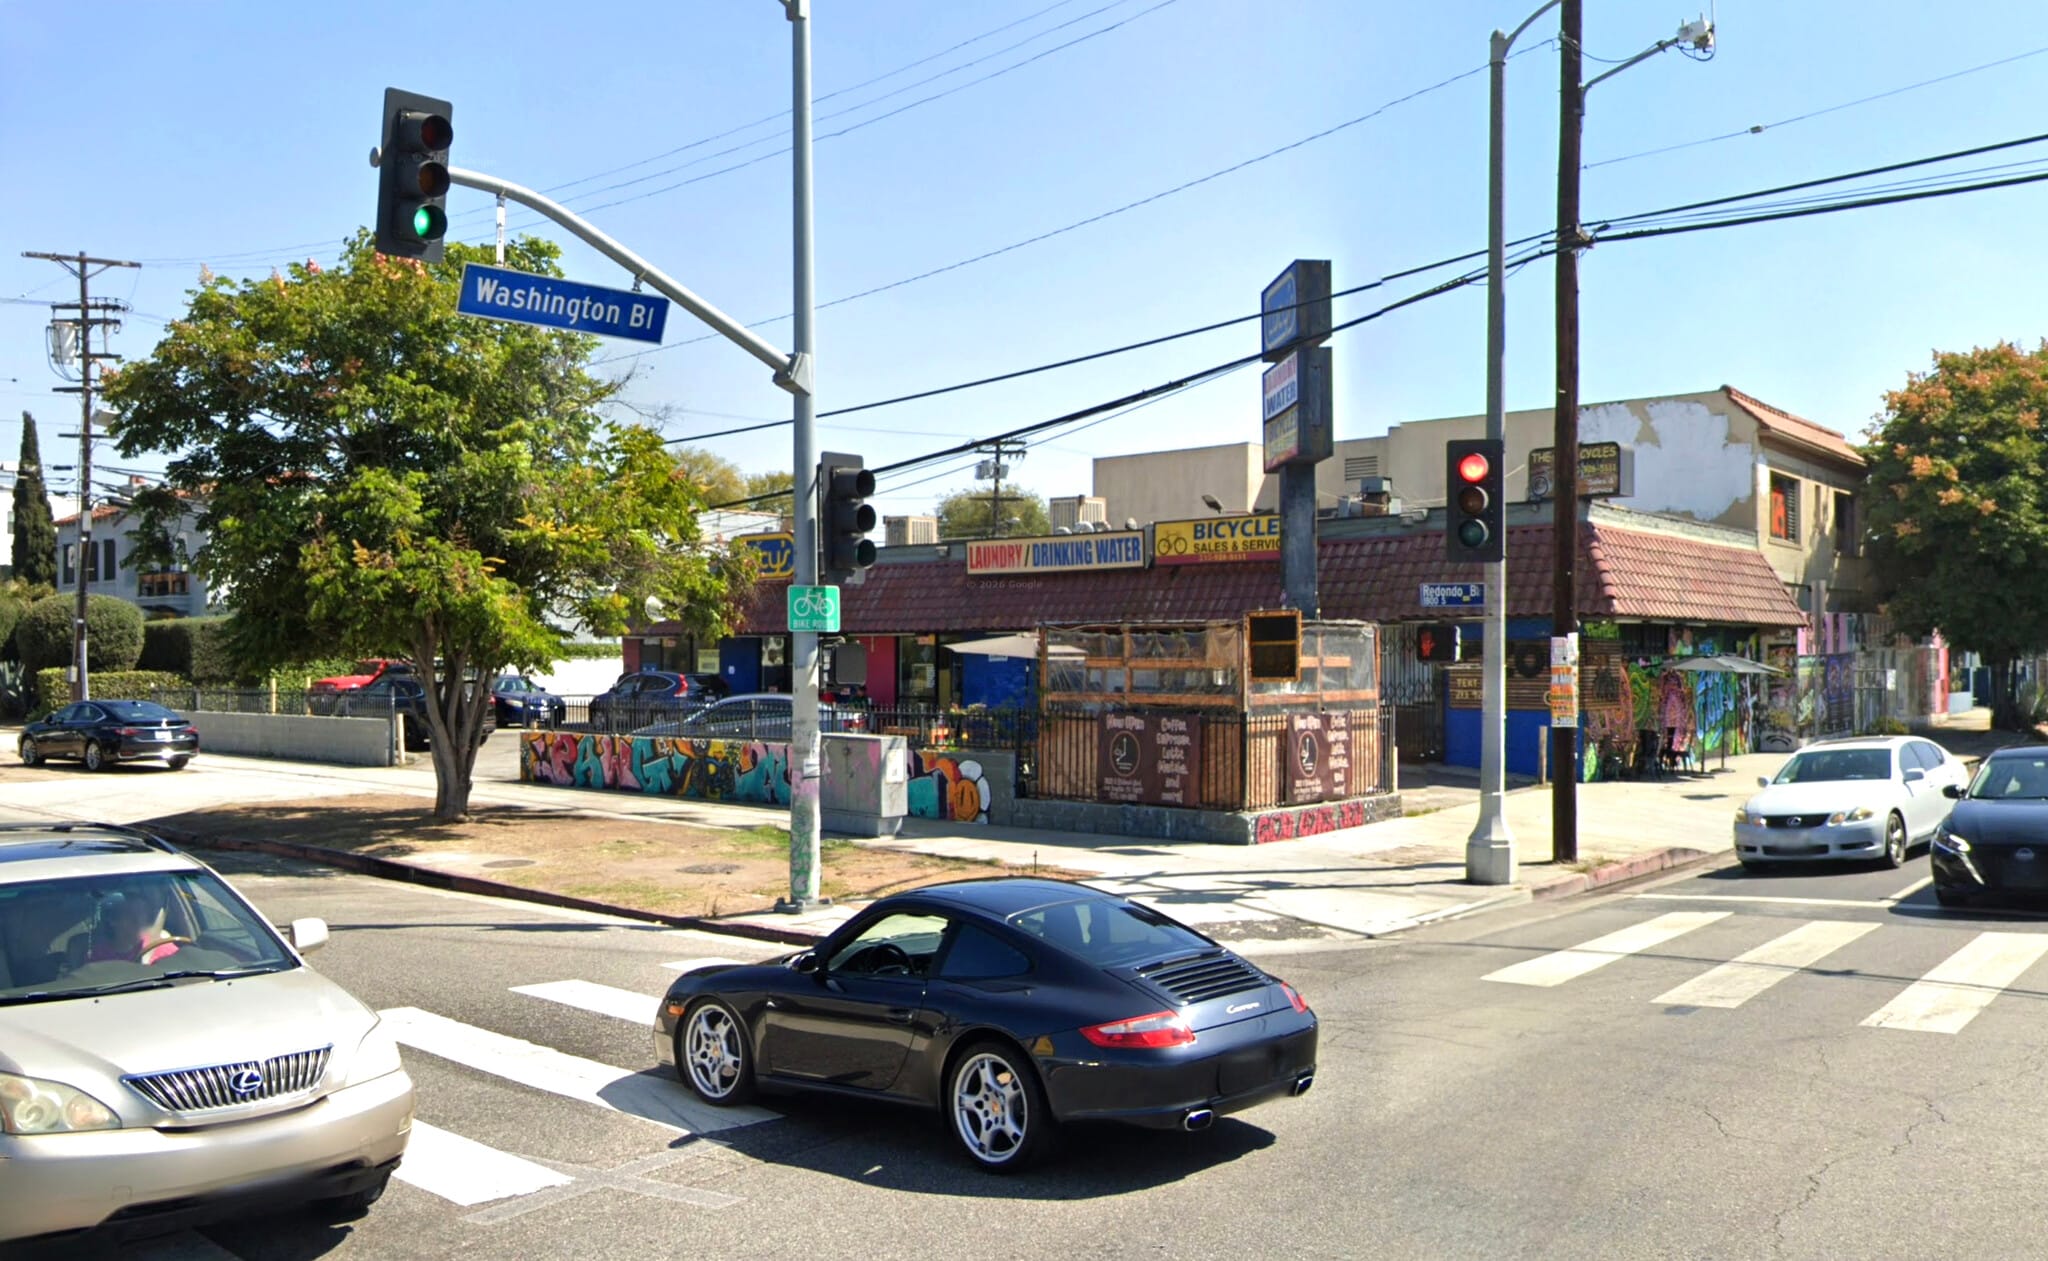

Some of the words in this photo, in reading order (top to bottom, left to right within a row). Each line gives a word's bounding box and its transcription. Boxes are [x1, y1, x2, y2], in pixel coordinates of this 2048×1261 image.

[477, 276, 620, 325] Washington
[630, 303, 654, 329] Bl
[1266, 381, 1297, 416] WATER
[1193, 518, 1280, 540] BICYCLE
[969, 544, 1023, 569] LAUNDRY
[1032, 539, 1094, 567] DRINKING
[1095, 536, 1141, 564] WATER
[1193, 541, 1229, 553] SALES
[1231, 541, 1239, 551] &
[1242, 538, 1280, 551] SERVIC
[1423, 584, 1463, 598] Redondo
[793, 620, 810, 629] BIKE
[812, 620, 834, 629] ROUTE
[1456, 678, 1479, 688] TEXT
[1226, 1002, 1260, 1014] Carrera
